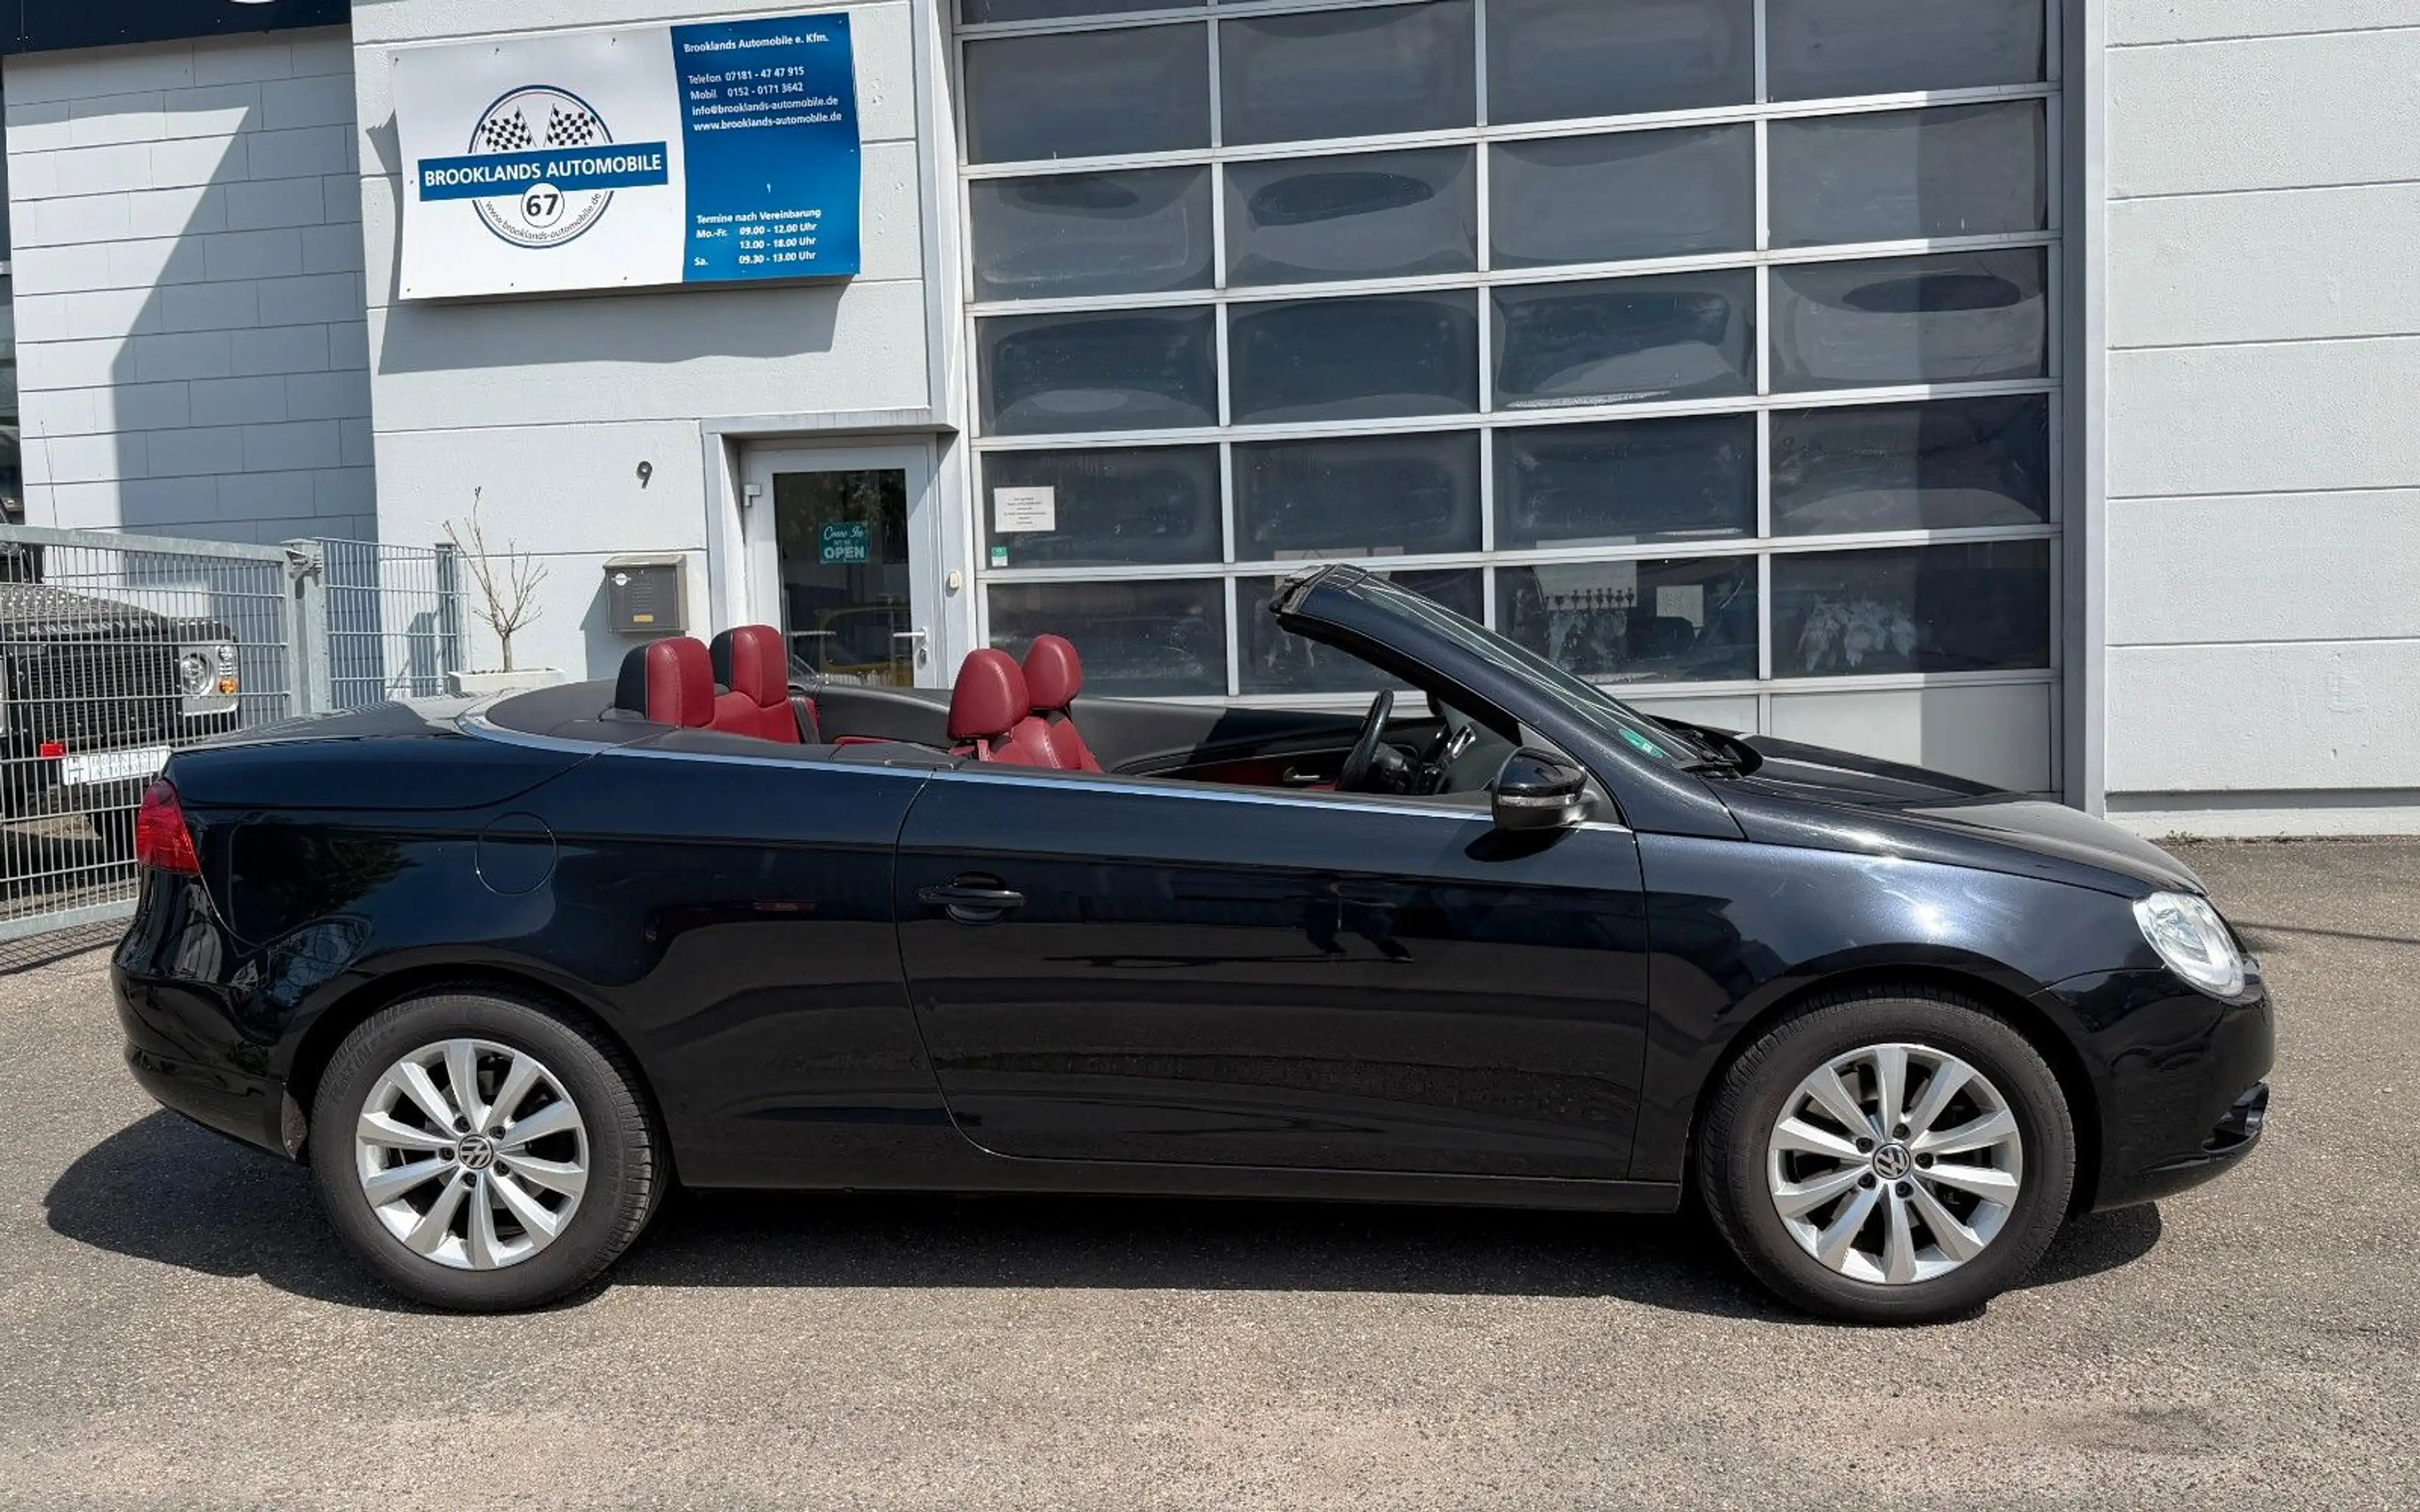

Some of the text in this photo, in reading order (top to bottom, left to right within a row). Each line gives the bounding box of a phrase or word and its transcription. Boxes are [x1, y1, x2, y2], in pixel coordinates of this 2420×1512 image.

[684, 40, 736, 53] Brooklands
[738, 35, 793, 49] Automobile
[806, 32, 829, 43] Kfm.
[688, 73, 722, 84] Telefon
[725, 70, 752, 82] 07181
[761, 68, 771, 79] 47
[774, 67, 785, 77] 47
[788, 66, 805, 76] 915
[690, 89, 717, 100] Mobil
[727, 86, 749, 97] 0152
[758, 84, 779, 94] 0171
[781, 82, 804, 93] 3642
[692, 95, 839, 117] info@brooklands-automobile.de
[693, 112, 842, 132] www.brooklands-automobile.de
[424, 154, 662, 186] BROOKLANDS AUTOMOBILE
[526, 193, 560, 217] 67
[485, 193, 602, 241] www.brooklands-automobile.de
[696, 209, 821, 224] Termine nach Vereinbarung
[696, 229, 727, 239] Mo.-Fr.
[739, 226, 765, 236] 09.00
[773, 224, 798, 234] 12.00
[800, 222, 817, 231] Uhr
[739, 240, 764, 249] 13.00
[773, 238, 797, 248] 18.00
[799, 236, 816, 246] Uhr
[694, 257, 709, 266] Sa.
[739, 255, 764, 264] 09.30
[773, 253, 796, 263] 13.00
[799, 251, 816, 260] Uhr
[637, 461, 653, 489] 9
[824, 546, 865, 559] OPEN
[84, 619, 155, 632] ROVER
